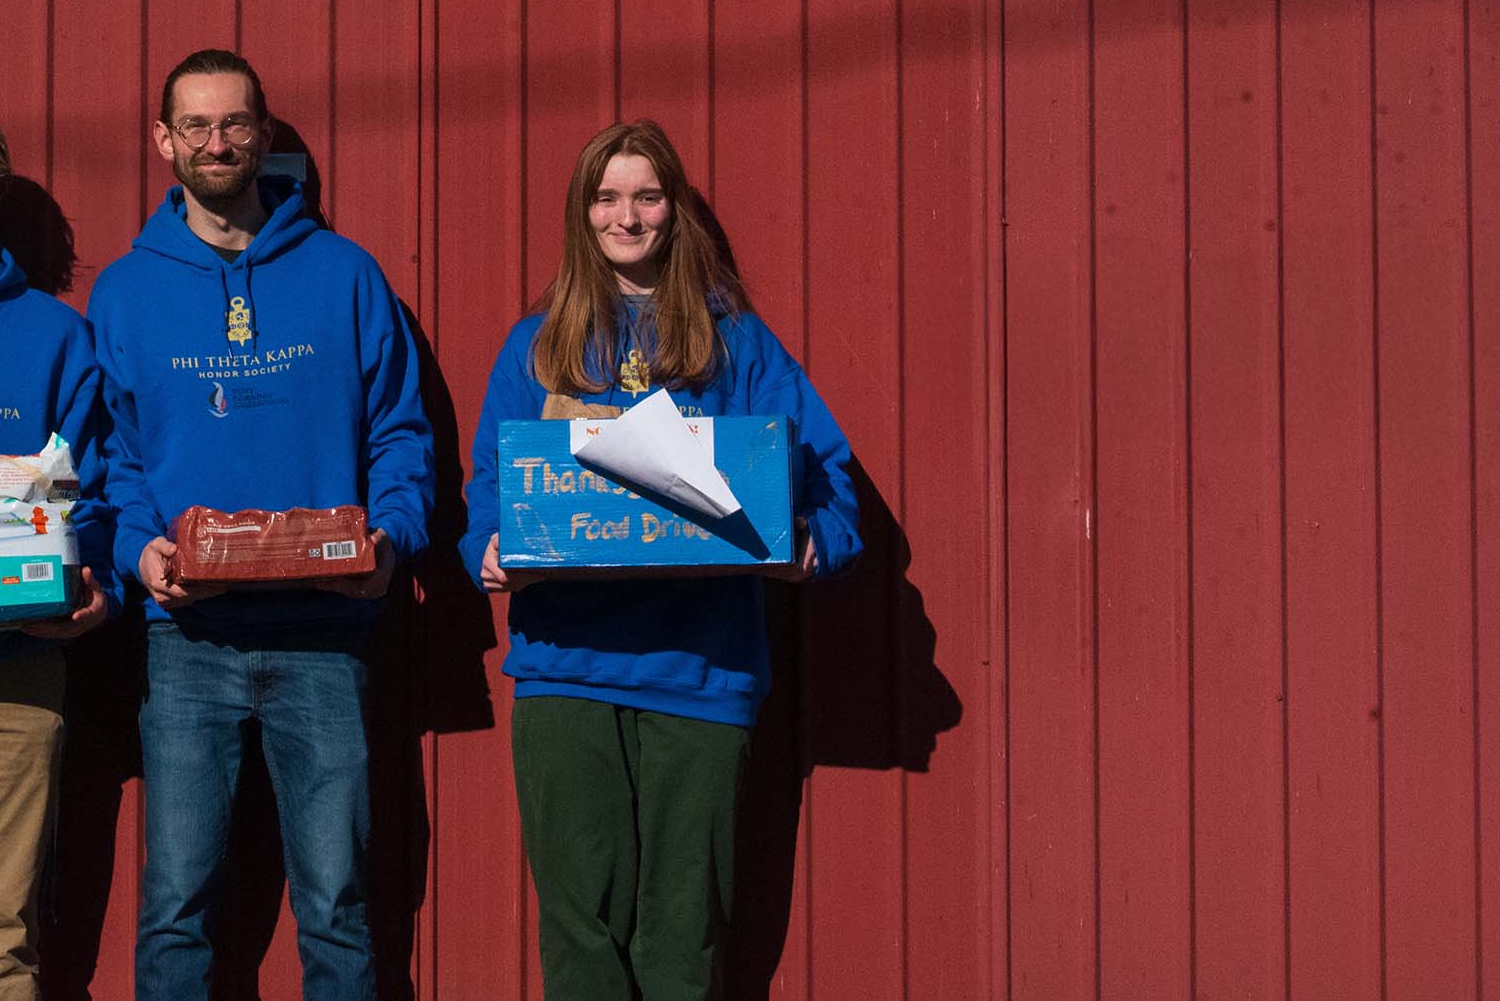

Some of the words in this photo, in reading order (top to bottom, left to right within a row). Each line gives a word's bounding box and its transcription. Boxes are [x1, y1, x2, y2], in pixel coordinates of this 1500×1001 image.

[172, 357, 199, 369] PHI
[205, 354, 260, 367] THETA
[266, 344, 314, 363] KAPPA
[198, 371, 239, 379] HONOR
[244, 363, 291, 377] SOCIETY
[570, 512, 630, 540] Food
